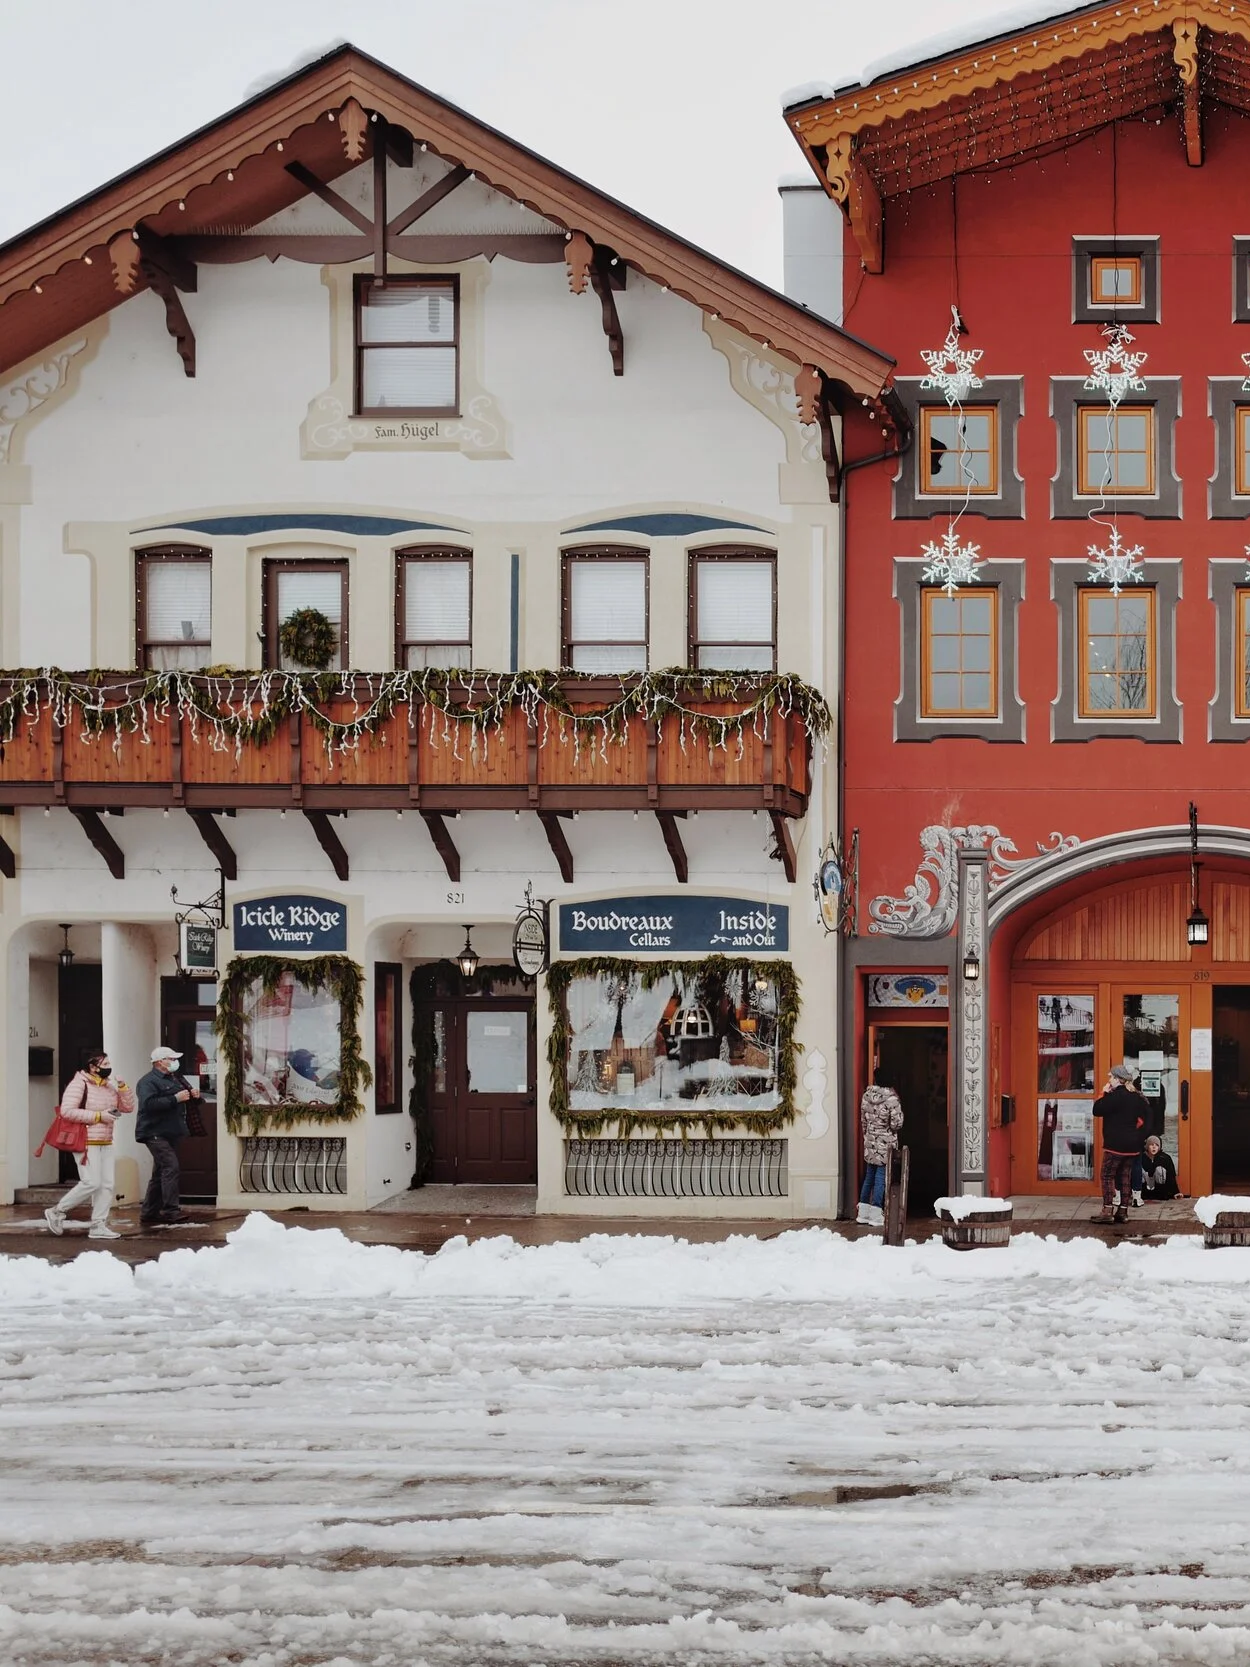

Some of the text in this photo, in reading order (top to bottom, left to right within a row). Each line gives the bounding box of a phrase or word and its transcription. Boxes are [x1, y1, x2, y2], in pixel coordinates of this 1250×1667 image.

[374, 422, 440, 441] Fam. Hügel
[446, 892, 465, 904] 821
[240, 905, 341, 932] Icicle Ridge
[571, 910, 674, 931] Boudreaux
[719, 910, 777, 931] Inside
[268, 927, 315, 945] Winery
[629, 932, 671, 946] Cellars
[731, 934, 776, 946] and Out
